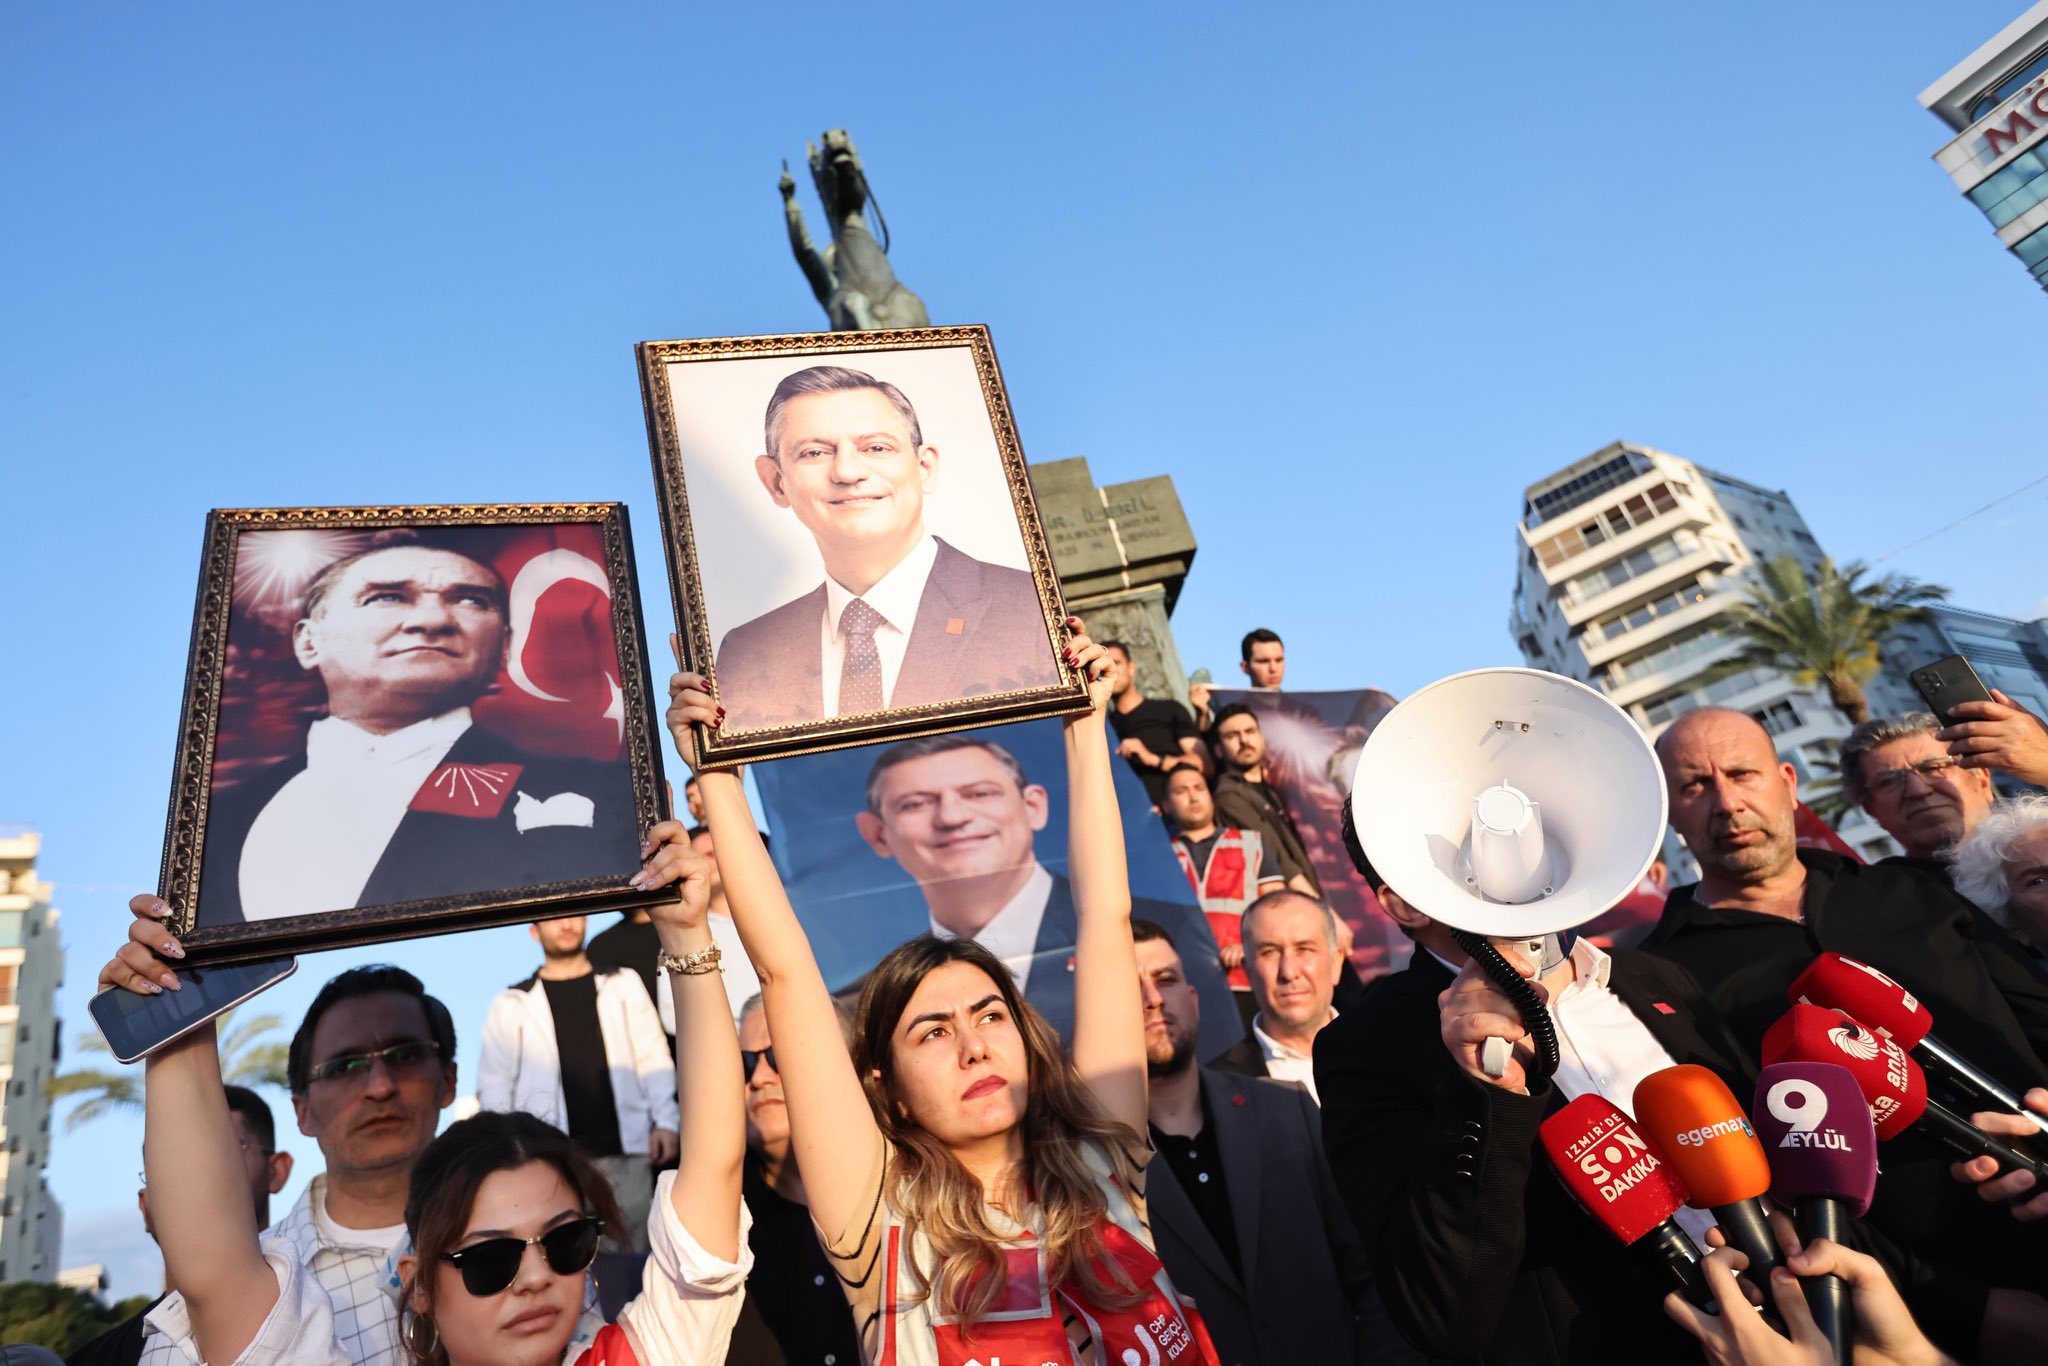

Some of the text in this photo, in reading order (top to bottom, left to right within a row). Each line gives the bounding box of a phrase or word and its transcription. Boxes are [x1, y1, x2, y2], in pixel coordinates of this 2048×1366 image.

[1766, 1078, 1828, 1132] 9
[1869, 1095, 1895, 1119] ka
[1676, 1116, 1746, 1147] egemax
[1788, 1128, 1852, 1152] EYLÜL
[1580, 1125, 1647, 1185] SON
